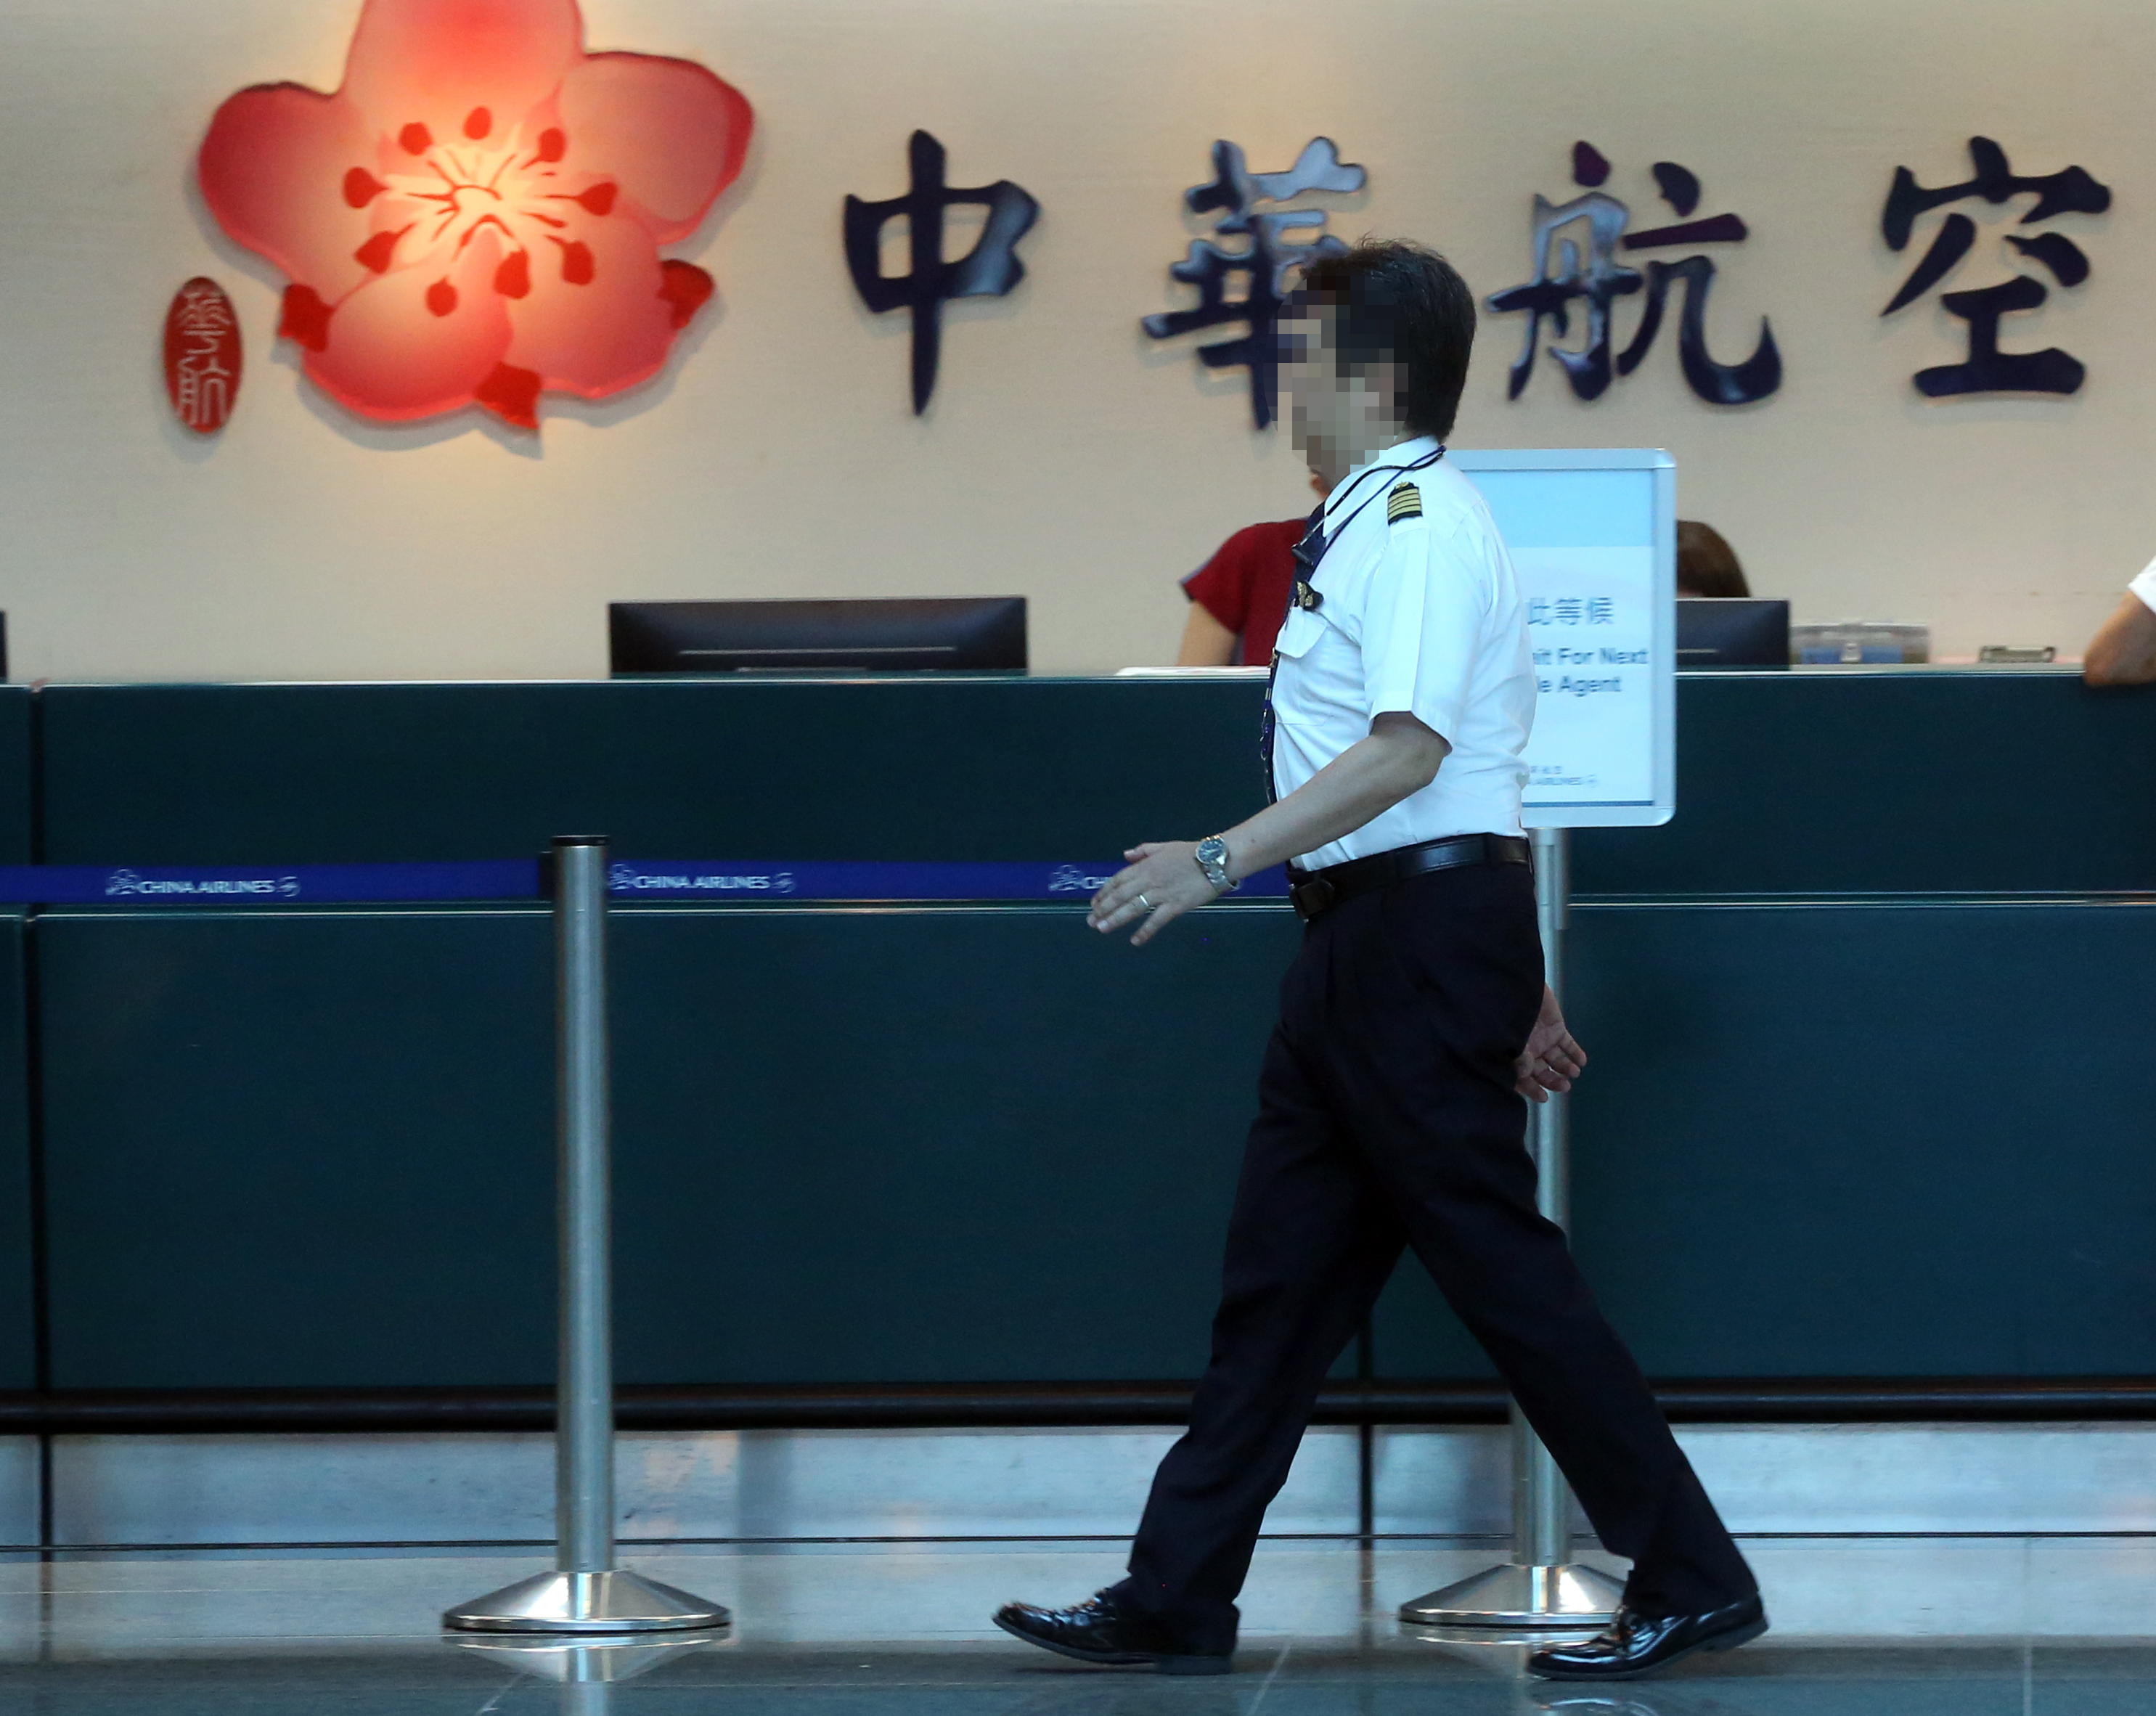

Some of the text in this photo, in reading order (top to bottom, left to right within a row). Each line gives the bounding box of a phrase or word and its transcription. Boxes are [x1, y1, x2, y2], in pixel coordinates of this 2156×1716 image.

[842, 129, 2112, 430] 中華航空
[1527, 597, 1614, 625] 此等候
[1532, 647, 1649, 665] ait For Next
[1557, 675, 1622, 697] Agent
[138, 880, 275, 893] CHINA AIRLINES
[634, 875, 770, 888] CHINA AIRLINES
